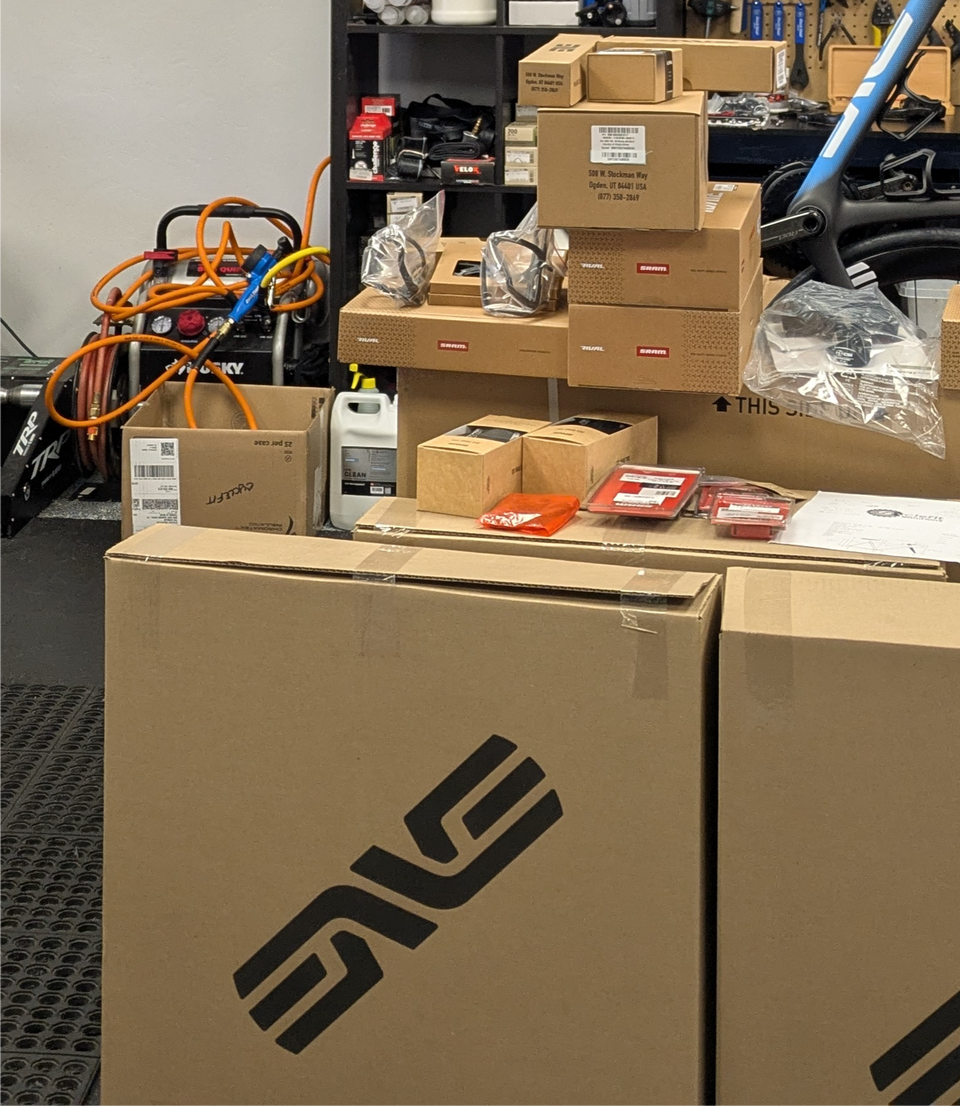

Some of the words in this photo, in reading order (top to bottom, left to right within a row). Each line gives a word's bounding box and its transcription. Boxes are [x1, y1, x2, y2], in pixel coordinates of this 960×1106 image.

[371, 140, 380, 175] challenge
[600, 170, 607, 178] W.
[607, 170, 635, 179] Stockman
[636, 171, 649, 181] Way
[588, 180, 608, 190] Ogden,
[609, 181, 616, 189] UT
[635, 183, 647, 191] USA
[597, 192, 612, 201] (877)
[639, 264, 668, 273] SRAM
[439, 342, 467, 350] SRAM
[639, 348, 668, 356] SRAM
[735, 396, 780, 416] THIS
[12, 410, 39, 457] TRP
[30, 429, 72, 481] TRP
